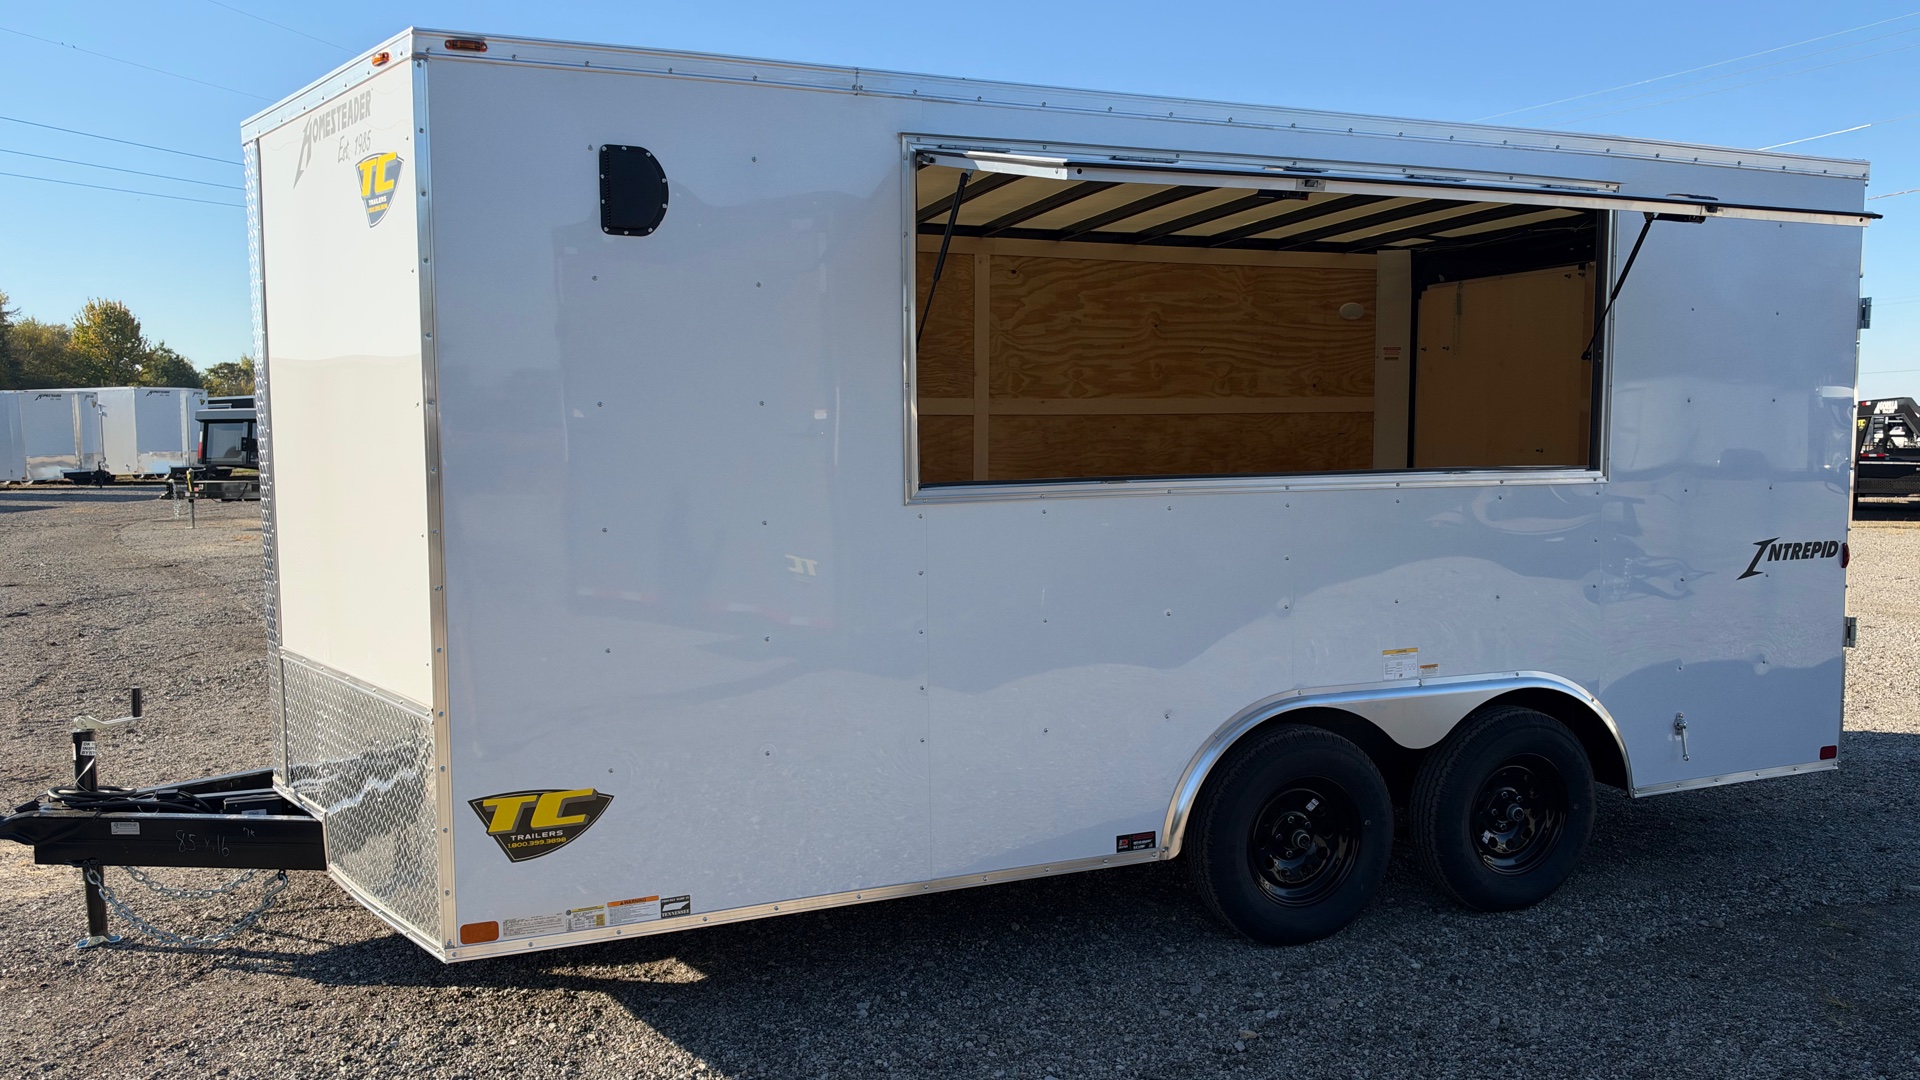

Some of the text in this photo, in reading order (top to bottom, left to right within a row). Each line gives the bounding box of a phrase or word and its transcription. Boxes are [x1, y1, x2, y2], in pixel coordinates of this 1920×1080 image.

[293, 90, 372, 190] HOMESTEADER
[338, 129, 372, 163] Est. 1985
[359, 151, 397, 197] TC
[1736, 536, 1840, 581] INTREPID
[482, 787, 598, 834] TC
[510, 829, 564, 841] TRAILERS
[624, 897, 647, 905] WARNING
[662, 909, 690, 917] TENNESSEE
